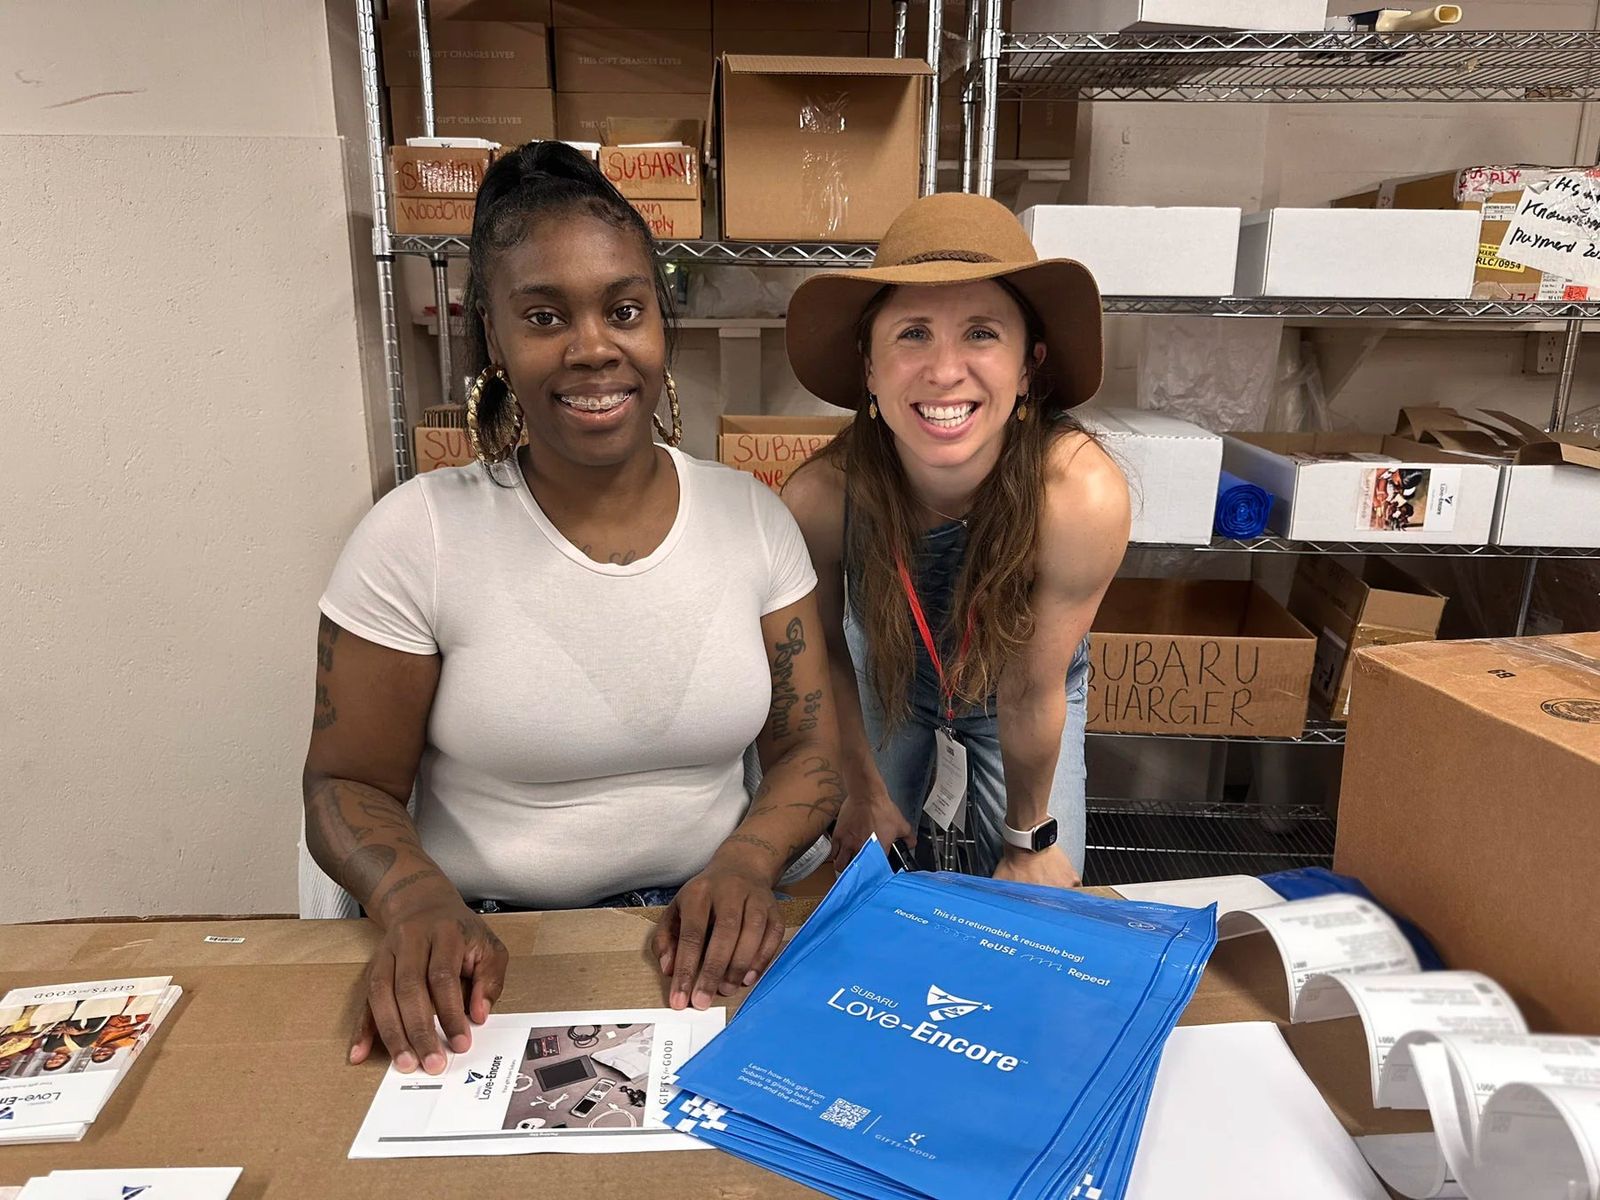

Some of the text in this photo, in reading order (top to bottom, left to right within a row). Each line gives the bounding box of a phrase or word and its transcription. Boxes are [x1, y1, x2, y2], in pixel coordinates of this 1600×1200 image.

[491, 50, 515, 58] LIVES
[498, 116, 522, 125] LIVES
[894, 908, 1111, 986] Reduce ReUSE Repeat
[932, 908, 949, 919] This
[950, 914, 957, 922] is
[965, 920, 1011, 939] returnable
[1012, 934, 1019, 942] &
[1020, 937, 1060, 955] reusable
[1061, 950, 1085, 963] bag!
[34, 988, 77, 999] GOOD
[92, 984, 135, 994] GIFTS
[850, 985, 899, 1009] SUBARU
[662, 1040, 673, 1066] GOOD
[478, 1055, 503, 1101] Love-Encore
[659, 1076, 670, 1105] GIFTS
[737, 1075, 763, 1088] people
[763, 1086, 778, 1094] and
[778, 1092, 790, 1100] the
[741, 1068, 765, 1080] Subaru
[771, 1081, 793, 1094] giving
[794, 1091, 811, 1101] back
[748, 1062, 826, 1100] Learn how this gift from
[874, 1134, 902, 1148] GIFTS
[909, 1147, 936, 1160] GOOD
